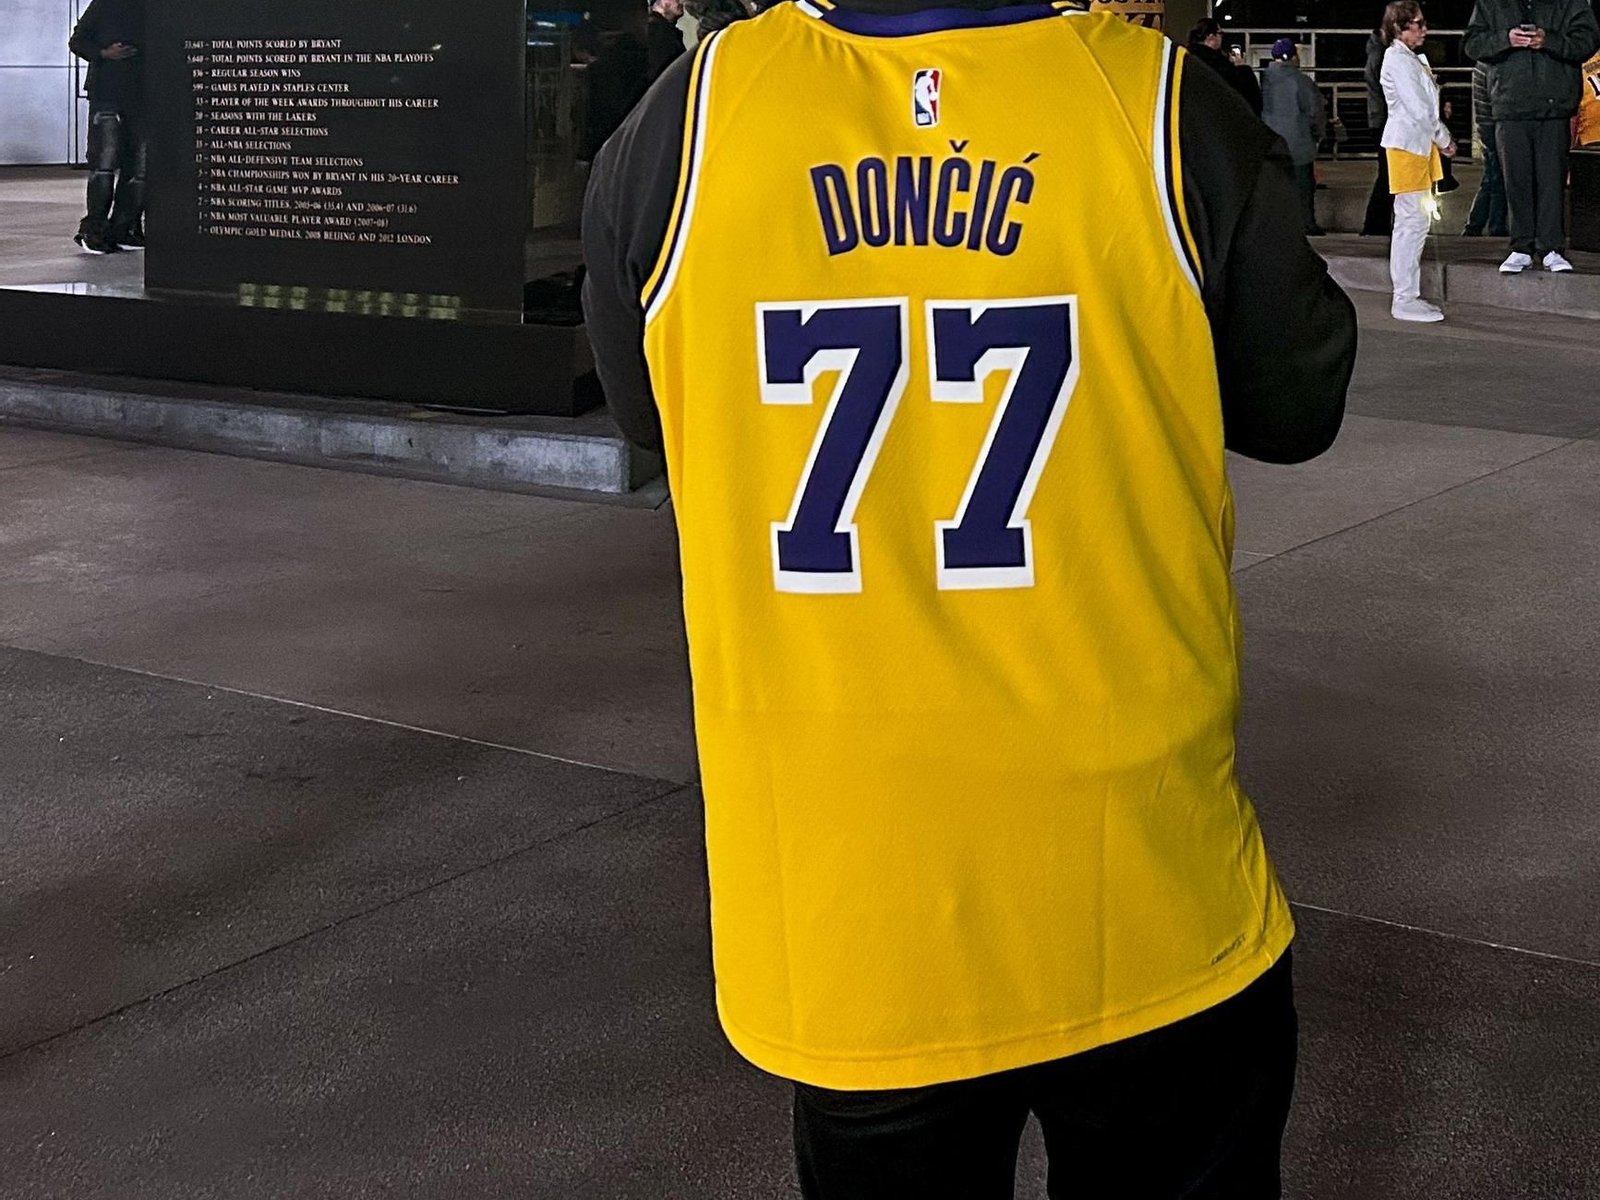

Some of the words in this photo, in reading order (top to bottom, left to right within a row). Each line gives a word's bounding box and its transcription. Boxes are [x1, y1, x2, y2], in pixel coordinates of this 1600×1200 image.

[211, 40, 234, 49] TOTAL
[236, 40, 263, 49] POINTS
[264, 40, 297, 49] SCORED
[311, 40, 342, 49] BRYANT
[211, 54, 234, 63] TOTAL
[236, 54, 264, 63] POINTS
[265, 54, 297, 63] SCORED
[310, 54, 341, 63] BRYANT
[355, 54, 372, 63] THE
[374, 54, 392, 63] NBA
[394, 54, 435, 63] PLAYOFFS
[211, 69, 248, 78] REGULAR
[249, 69, 279, 78] SEASON
[280, 69, 302, 78] WINS
[210, 83, 238, 92] GAMES
[239, 83, 270, 92] PLAYED
[282, 83, 316, 92] STAPLES
[316, 84, 350, 93] CENTER
[211, 98, 240, 107] PLAYER
[254, 98, 269, 107] THE
[271, 98, 295, 107] WEEK
[296, 98, 329, 107] AWARDS
[330, 99, 387, 108] THROUGHOUT
[388, 99, 403, 108] HIS
[404, 99, 439, 108] CAREER
[210, 112, 244, 121] SEASONS
[245, 112, 266, 121] WITH
[267, 112, 283, 121] THE
[285, 113, 317, 122] LAKERS
[210, 126, 241, 135] CAREER
[281, 127, 329, 136] SELECTIONS
[244, 141, 292, 150] SELECTIONS
[210, 155, 227, 164] NBA
[290, 157, 313, 166] TEAM
[314, 158, 364, 167] SELECTIONS
[210, 169, 226, 178] NBA
[227, 170, 291, 179] CHAMPIONSHIPS
[291, 171, 310, 180] WON
[325, 172, 356, 181] BRYANT
[370, 173, 385, 182] HIS
[387, 174, 422, 184] 20-YEAR
[424, 175, 459, 184] CAREER
[210, 183, 226, 192] NBA
[265, 186, 289, 195] GAME
[291, 185, 309, 194] MVP
[310, 187, 343, 196] AWARDS
[809, 139, 1041, 257] DONČIĆ
[210, 197, 226, 206] NBA
[227, 199, 262, 208] SCORING
[345, 203, 364, 212] AND
[210, 212, 226, 221] NBA
[227, 213, 249, 222] MOST
[249, 214, 289, 223] VALUABLE
[291, 216, 322, 225] PLAYER
[323, 217, 352, 226] AWARD
[209, 227, 244, 236] OLYMPIC
[244, 228, 268, 237] GOLD
[323, 232, 356, 241] BEIJING
[357, 233, 377, 242] AND
[396, 235, 432, 244] LONDON
[755, 294, 1081, 594] 77
